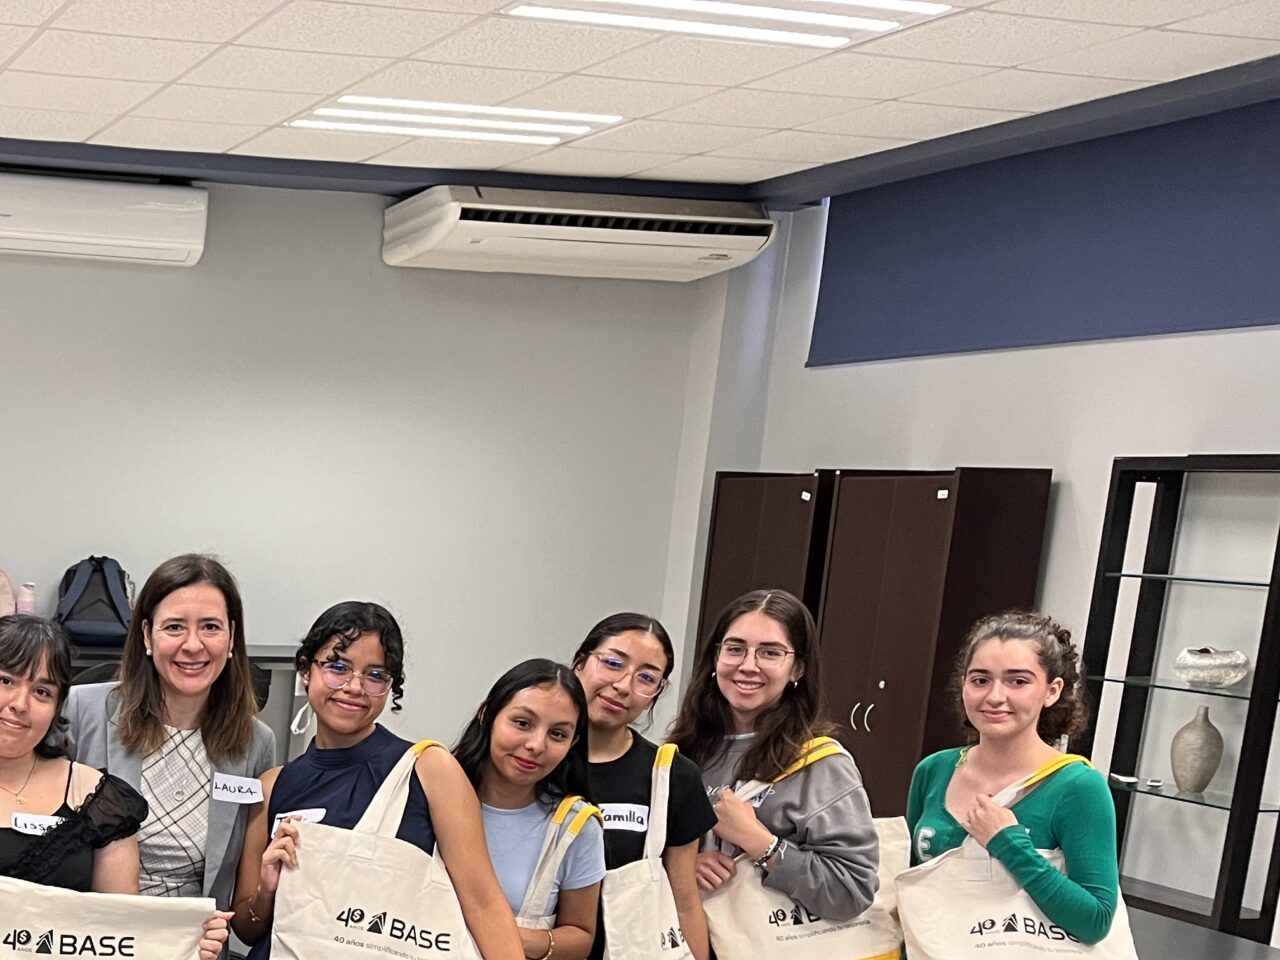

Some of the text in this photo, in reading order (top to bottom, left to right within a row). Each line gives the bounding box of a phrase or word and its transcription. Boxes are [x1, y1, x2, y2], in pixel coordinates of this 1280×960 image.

[214, 782, 257, 795] LAURA
[601, 808, 645, 826] amilla
[333, 936, 345, 944] 40
[389, 917, 451, 951] BASE
[59, 934, 135, 957] BASE
